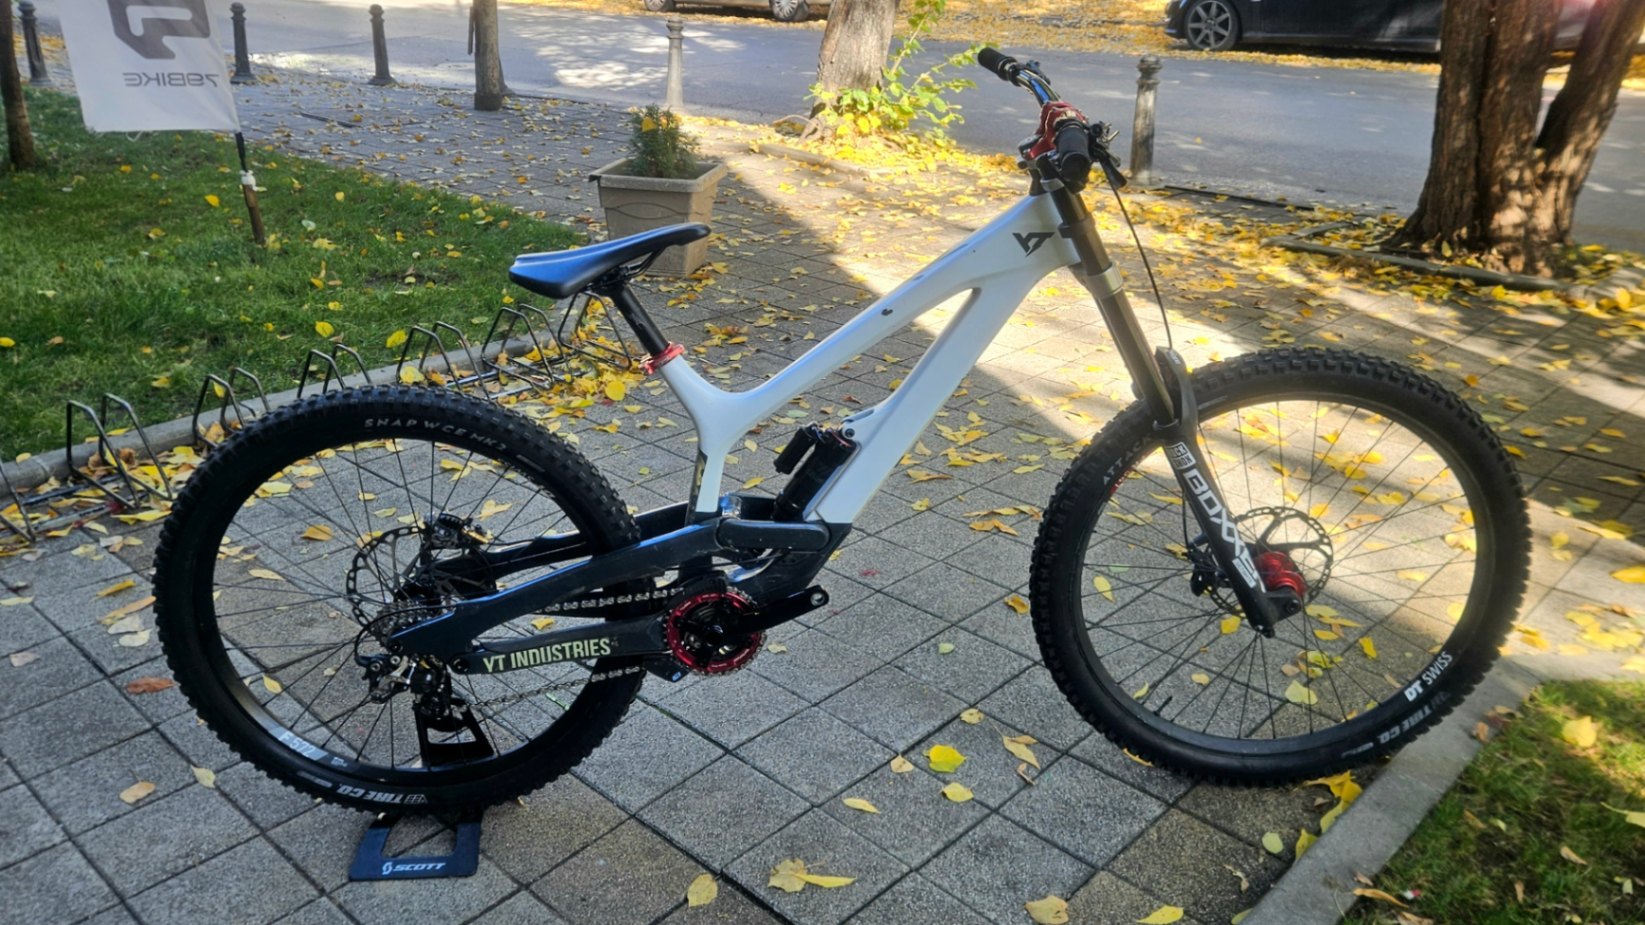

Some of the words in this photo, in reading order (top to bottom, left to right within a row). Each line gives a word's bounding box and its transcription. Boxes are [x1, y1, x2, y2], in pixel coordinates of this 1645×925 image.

[364, 418, 418, 428] SNAP
[482, 654, 506, 673] YT
[510, 638, 612, 669] INDUSTRIES
[1403, 679, 1424, 702] DT
[1421, 651, 1454, 686] SWISS
[365, 790, 403, 804] TIRE
[392, 862, 446, 872] SCOTT
